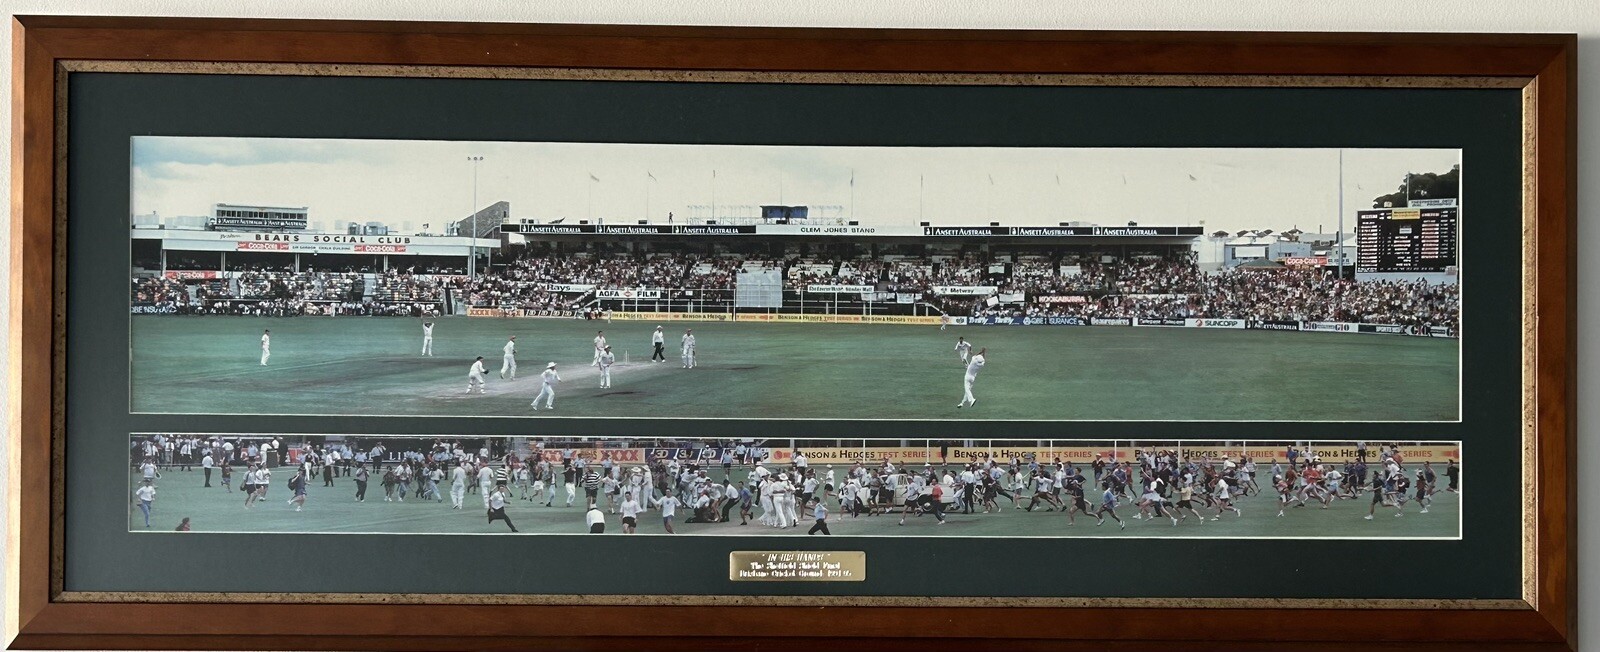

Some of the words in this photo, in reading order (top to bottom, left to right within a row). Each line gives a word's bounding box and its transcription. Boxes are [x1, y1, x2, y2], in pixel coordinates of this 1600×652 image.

[530, 225, 551, 233] ANSETT
[551, 225, 581, 233] AUSTRALIA
[605, 224, 627, 234] ANSETT
[627, 224, 659, 234] AUSTRALIA
[683, 224, 706, 234] ANSETT
[706, 224, 739, 234] AUSTRALIA
[935, 228, 959, 236] ANSETT
[959, 228, 992, 236] AUSTRALIA
[1020, 228, 1042, 236] ANSETT
[1042, 228, 1075, 236] AUSTRALIA
[1103, 227, 1126, 236] ANSETT
[1126, 227, 1158, 236] AUSTRALIA
[255, 233, 300, 242] BEARS
[313, 235, 365, 243] SOCIAL
[248, 242, 278, 250] Coca-Cola
[1287, 257, 1318, 265] Coca-Cola
[1044, 317, 1078, 325] ISURANCE
[1335, 323, 1350, 331] GIO
[600, 449, 639, 461] XXXX
[839, 449, 875, 459] HEDGES
[953, 449, 989, 458] BENSON
[1001, 449, 1037, 458] HEDGS
[1182, 449, 1218, 458] HEDGES
[1244, 450, 1274, 458] SERIES
[1332, 450, 1339, 458] &
[1341, 449, 1377, 458] HEDES
[1403, 450, 1433, 458] SERIES
[768, 553, 778, 562] IN
